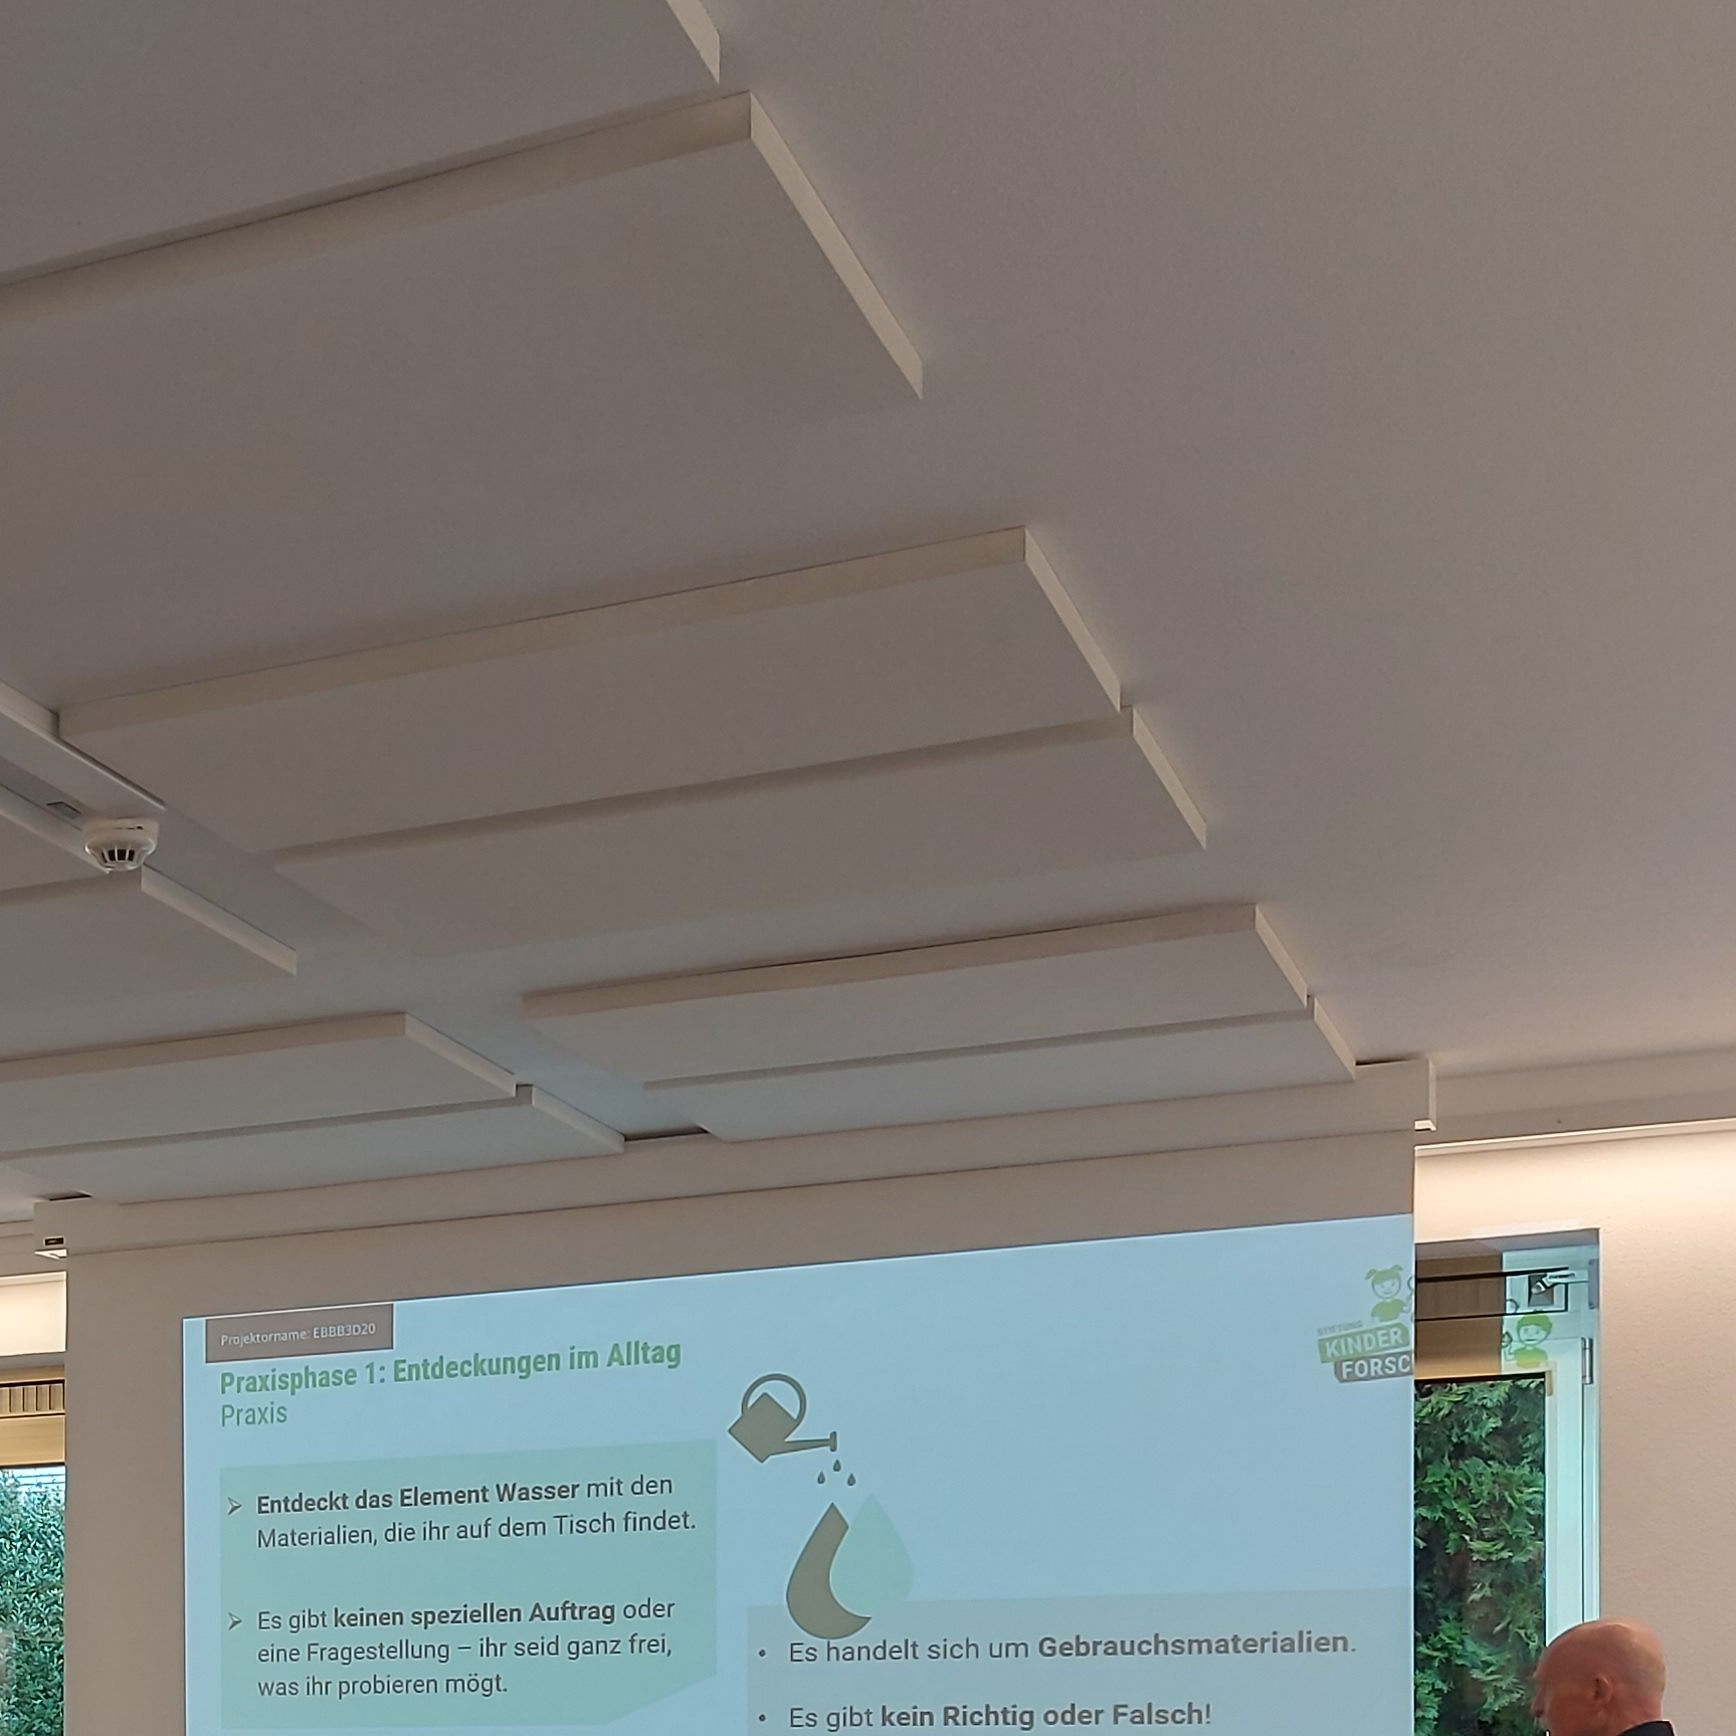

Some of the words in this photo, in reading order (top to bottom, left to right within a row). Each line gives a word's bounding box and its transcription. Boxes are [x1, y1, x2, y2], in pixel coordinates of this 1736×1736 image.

[220, 1330, 310, 1347] Projektorname:
[1326, 1327, 1402, 1359] KINDER
[221, 1365, 357, 1395] Praxisphase
[365, 1361, 385, 1384] 1:
[393, 1353, 561, 1382] Entdeckungen
[569, 1345, 599, 1369] im
[607, 1340, 681, 1369] Alltag
[1342, 1355, 1410, 1379] FORSC
[221, 1401, 287, 1427] Praxis
[257, 1491, 350, 1515] Entdeckt
[354, 1488, 393, 1509] das
[399, 1484, 490, 1508] Element
[495, 1480, 581, 1502] Wasser
[586, 1476, 624, 1499] mit
[630, 1475, 672, 1496] den
[257, 1524, 377, 1548] Materialien,
[383, 1522, 416, 1543] die
[422, 1520, 451, 1541] ihr
[456, 1517, 492, 1540] auf
[498, 1516, 547, 1538] dem
[553, 1511, 616, 1535] Tisch
[622, 1508, 697, 1533] findet.
[257, 1611, 283, 1631] Es
[288, 1609, 328, 1633] gibt
[333, 1607, 405, 1628] keinen
[410, 1602, 523, 1630] speziellen
[528, 1600, 617, 1626] Auftrag
[622, 1598, 676, 1620] oder
[257, 1643, 301, 1663] eine
[306, 1638, 451, 1665] Fragestellung
[479, 1637, 507, 1659] ihr
[513, 1635, 561, 1657] seid
[566, 1637, 622, 1661] ganz
[628, 1632, 672, 1657] frei,
[790, 1642, 817, 1662] Es
[826, 1638, 919, 1662] handelt
[927, 1637, 979, 1660] sich
[989, 1641, 1029, 1659] um
[1038, 1630, 1356, 1658] Gebrauchsmaterialien.
[257, 1679, 299, 1696] was
[306, 1674, 332, 1695] ihr
[338, 1674, 439, 1699] probieren
[445, 1674, 507, 1697] mögt.
[790, 1708, 817, 1728] Es
[826, 1706, 874, 1733] gibt
[881, 1705, 934, 1727] kein
[943, 1704, 1034, 1732] Richtig
[1043, 1703, 1104, 1725] oder
[1113, 1702, 1212, 1726] Falsch!
